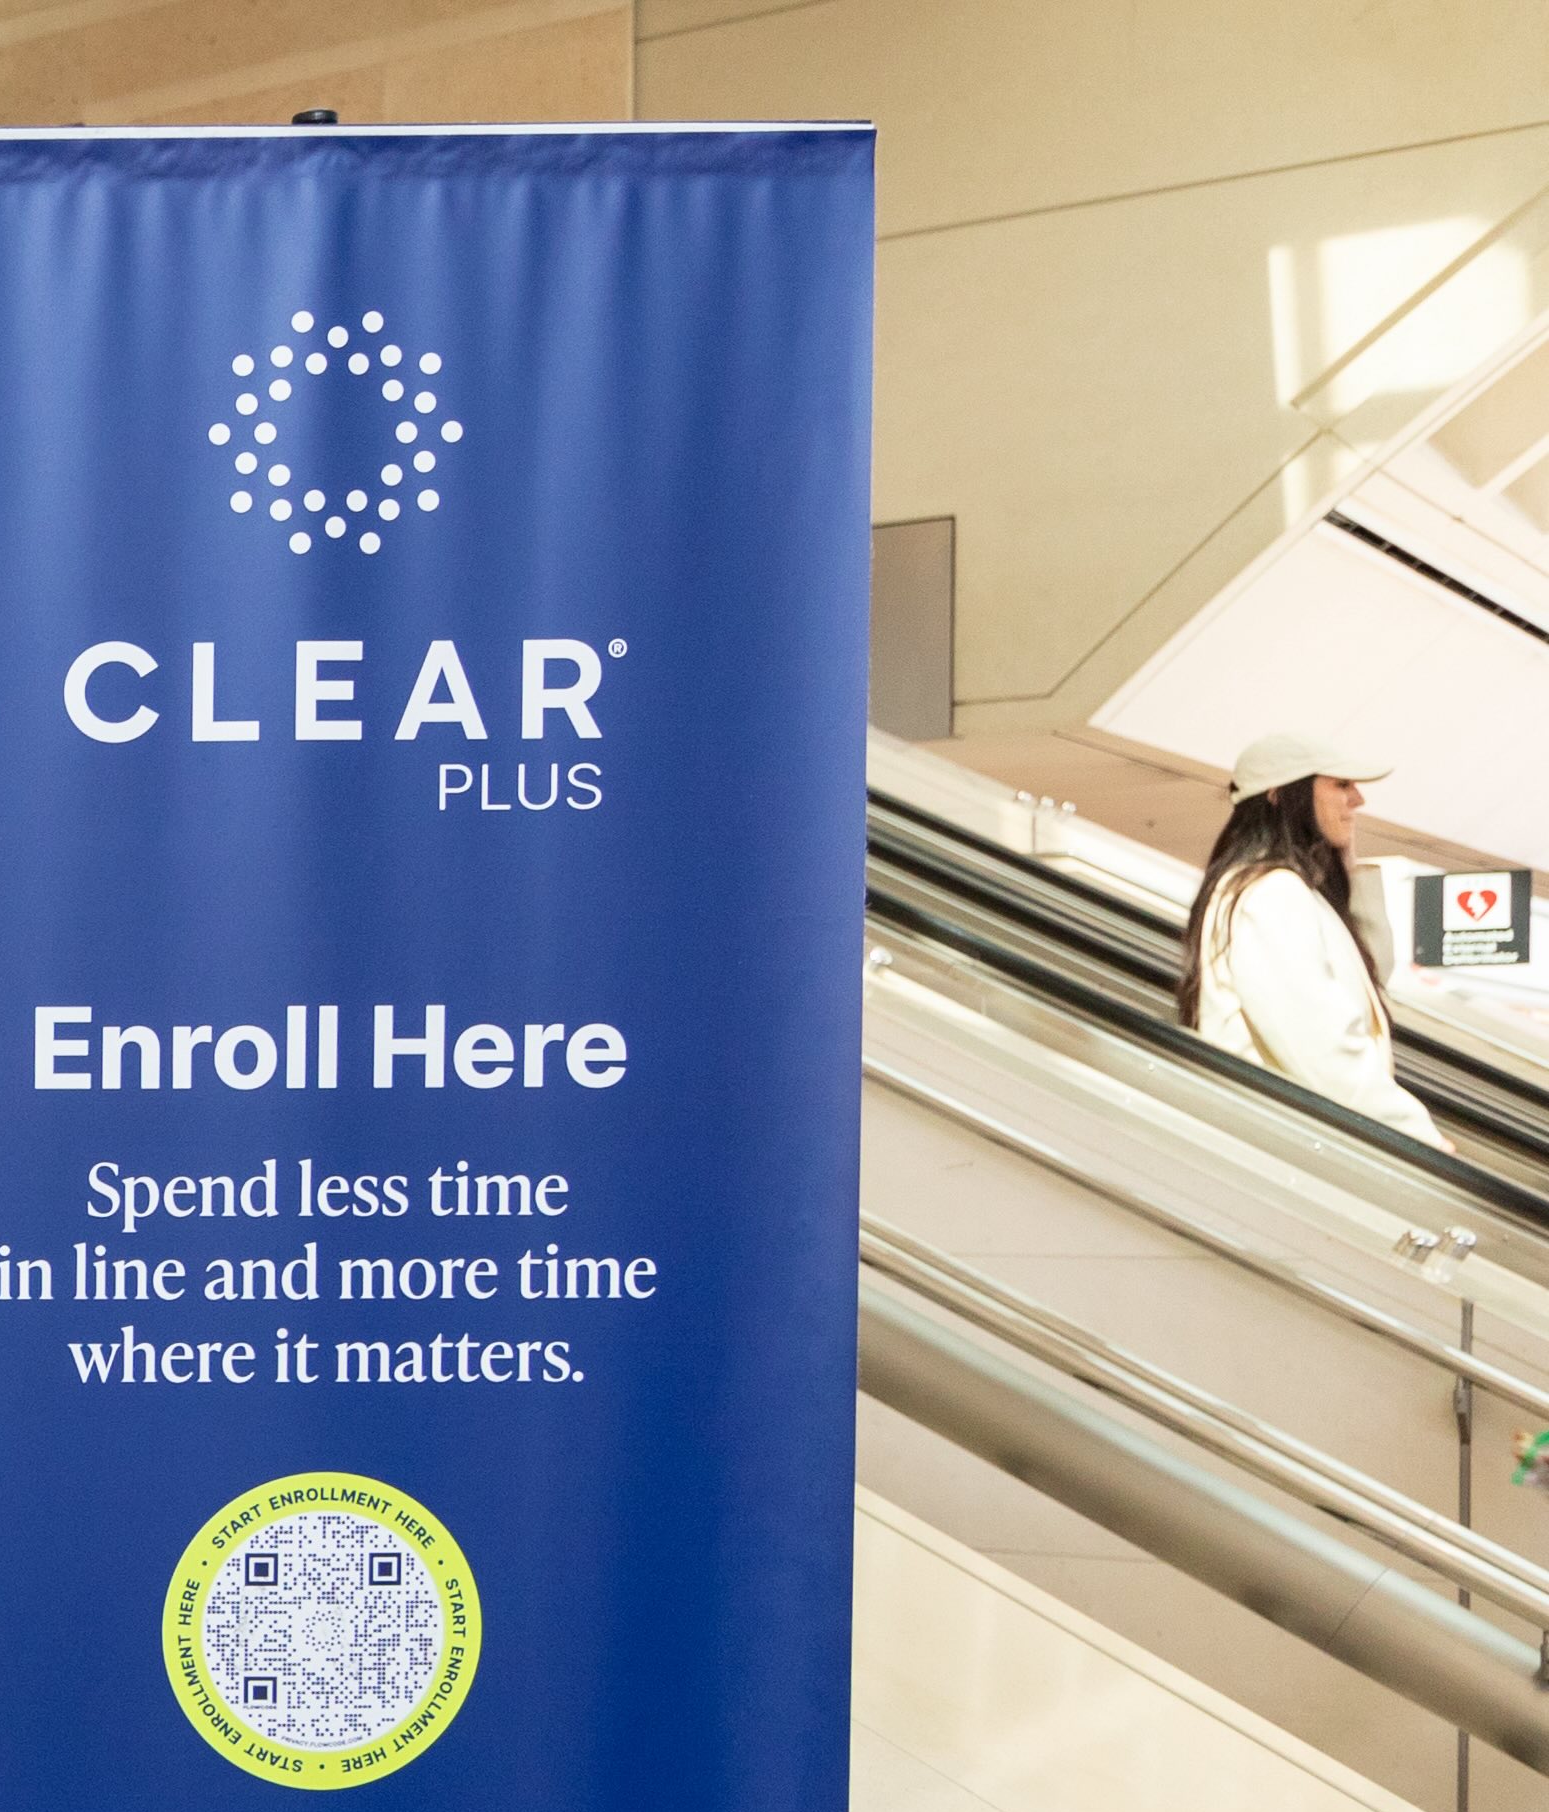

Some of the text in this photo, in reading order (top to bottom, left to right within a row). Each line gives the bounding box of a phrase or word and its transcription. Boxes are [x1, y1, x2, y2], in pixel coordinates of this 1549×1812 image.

[438, 762, 603, 811] PLUS
[34, 1004, 627, 1091] Enroll Here
[87, 1158, 569, 1233] Spend less time
[73, 1242, 186, 1301] line
[204, 1241, 320, 1301] and
[338, 1257, 499, 1300] more
[516, 1243, 657, 1300] time
[67, 1324, 584, 1384] where it matters.
[211, 1487, 436, 1549] START ENROLLMENT HERE
[177, 1578, 303, 1773] START ENROLLMENT HERE
[340, 1578, 466, 1773] START ENROLLMENT HERE
